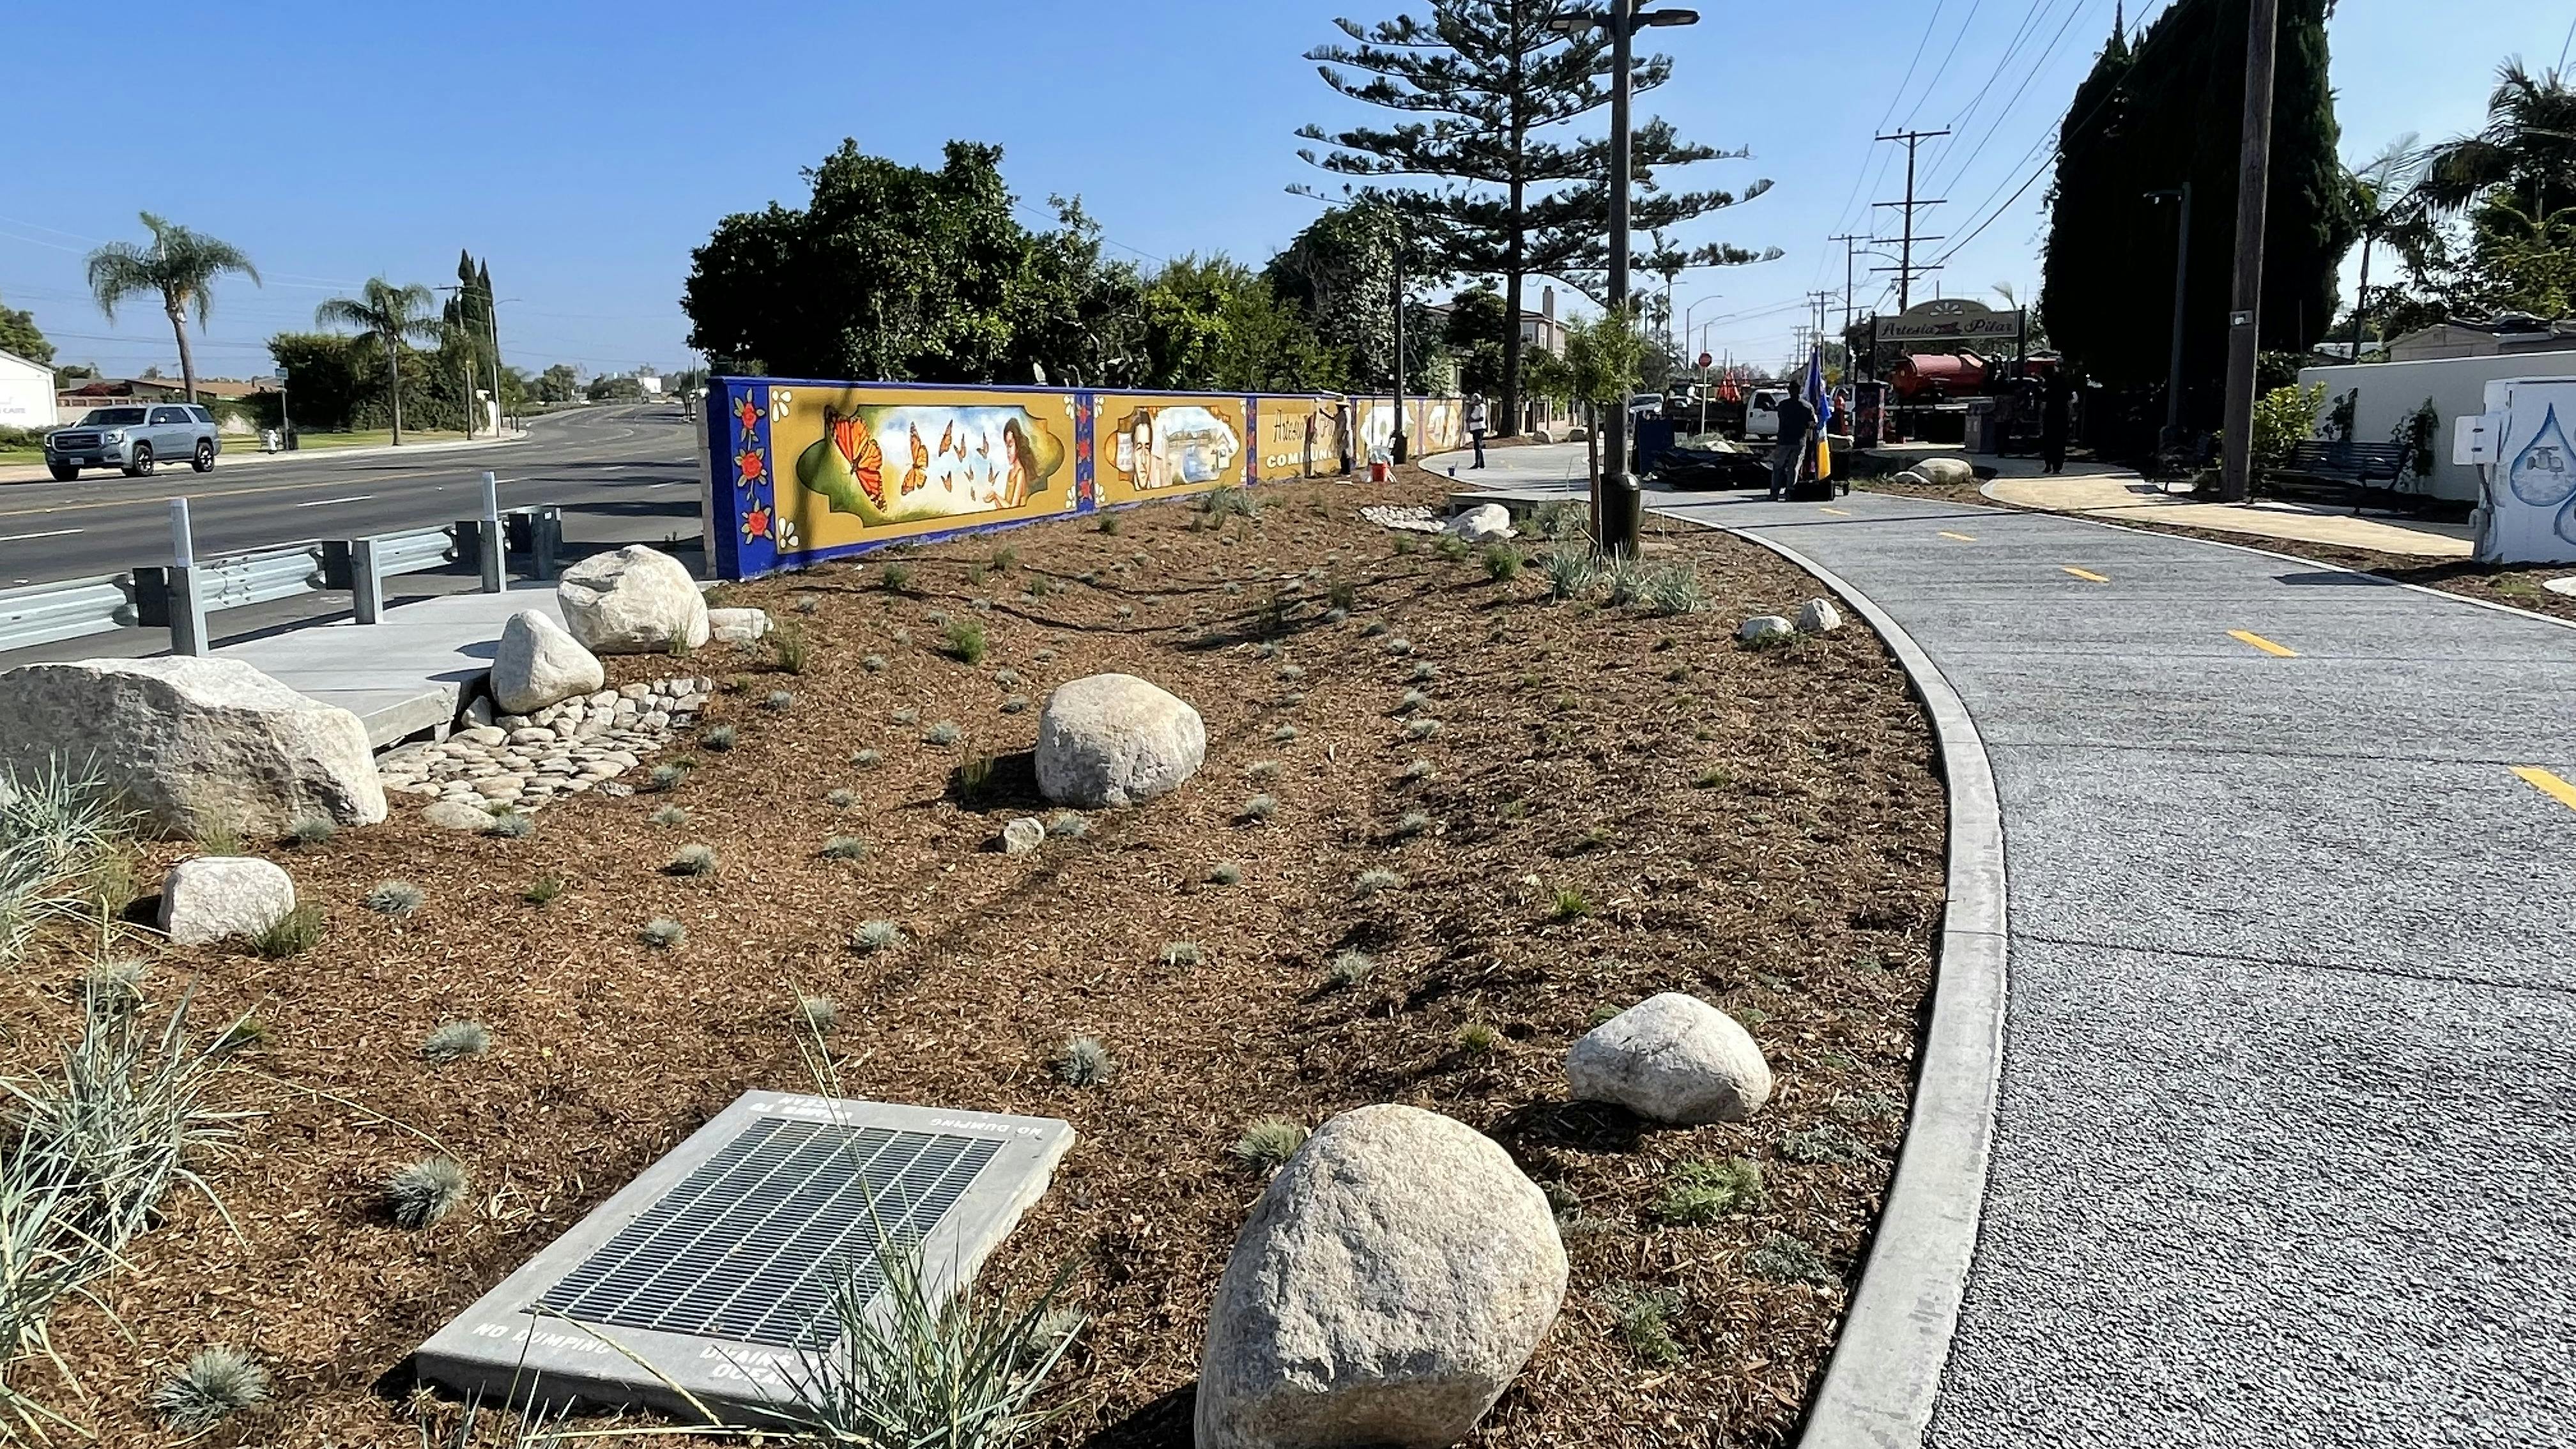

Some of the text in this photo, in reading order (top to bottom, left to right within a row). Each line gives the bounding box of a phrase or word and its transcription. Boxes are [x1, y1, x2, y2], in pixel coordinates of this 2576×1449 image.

[1881, 318, 2012, 337] Artesia Pilar
[930, 1118, 1043, 1136] NO DUMPING
[471, 1322, 612, 1354] NO DUMPING
